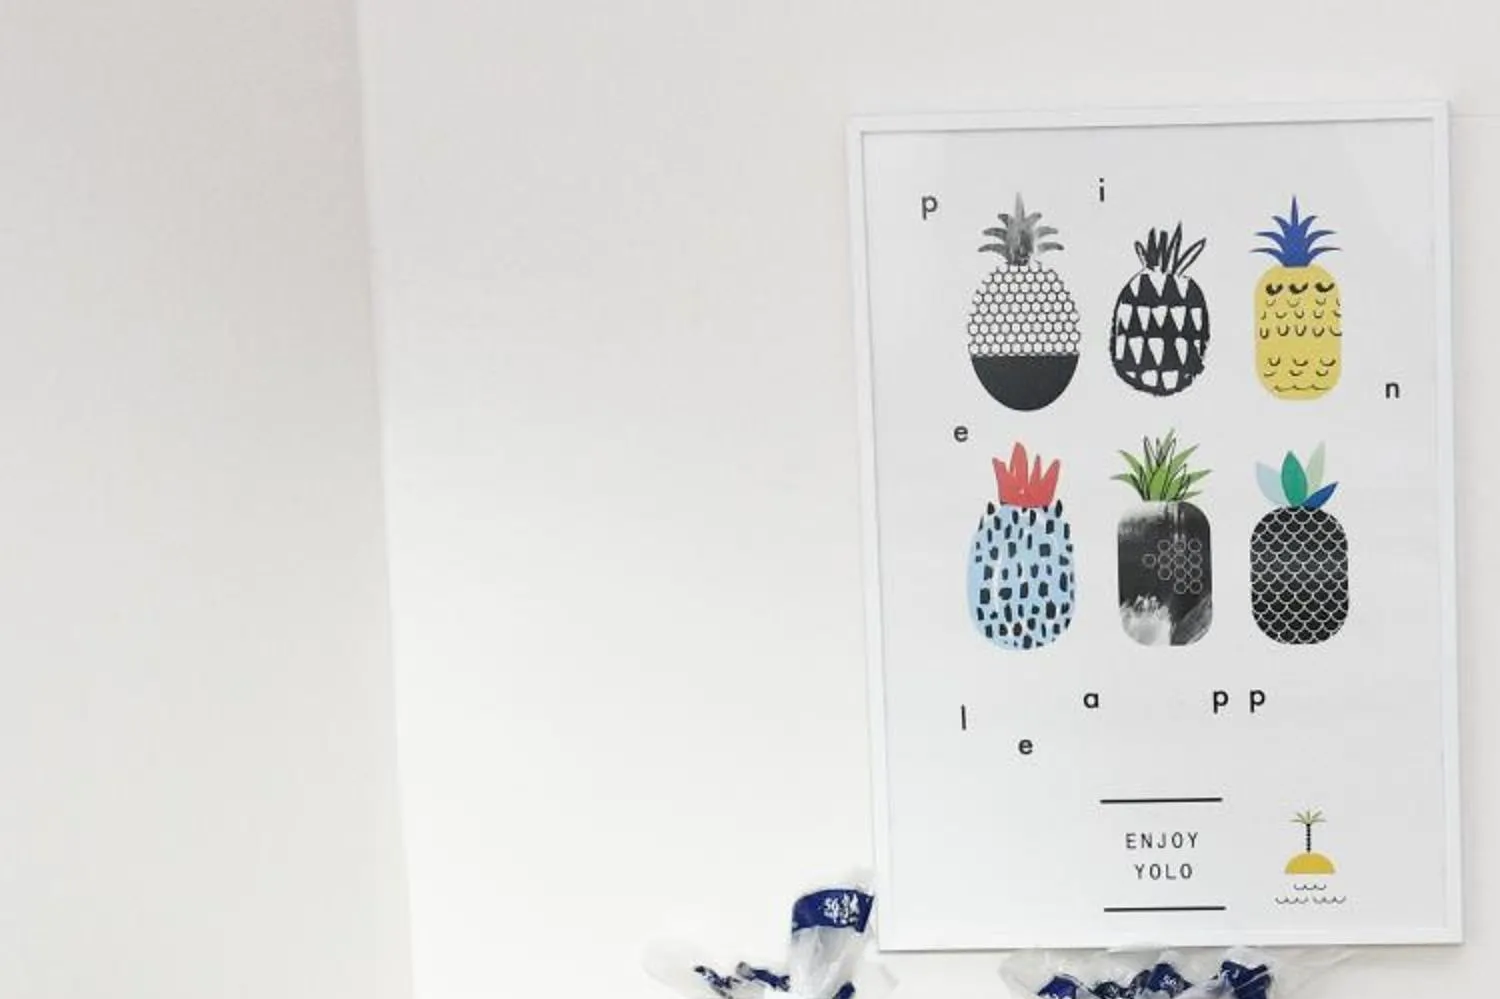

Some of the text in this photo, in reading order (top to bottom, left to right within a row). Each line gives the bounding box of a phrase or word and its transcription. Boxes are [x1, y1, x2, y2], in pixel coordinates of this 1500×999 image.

[1099, 177, 1105, 203] i
[921, 195, 938, 221] p
[1385, 382, 1400, 399] n
[953, 425, 969, 443] e
[1083, 689, 1266, 715] a p p
[1018, 739, 1033, 755] e
[1125, 831, 1199, 849] ENJOY
[1134, 863, 1194, 881] YOLO
